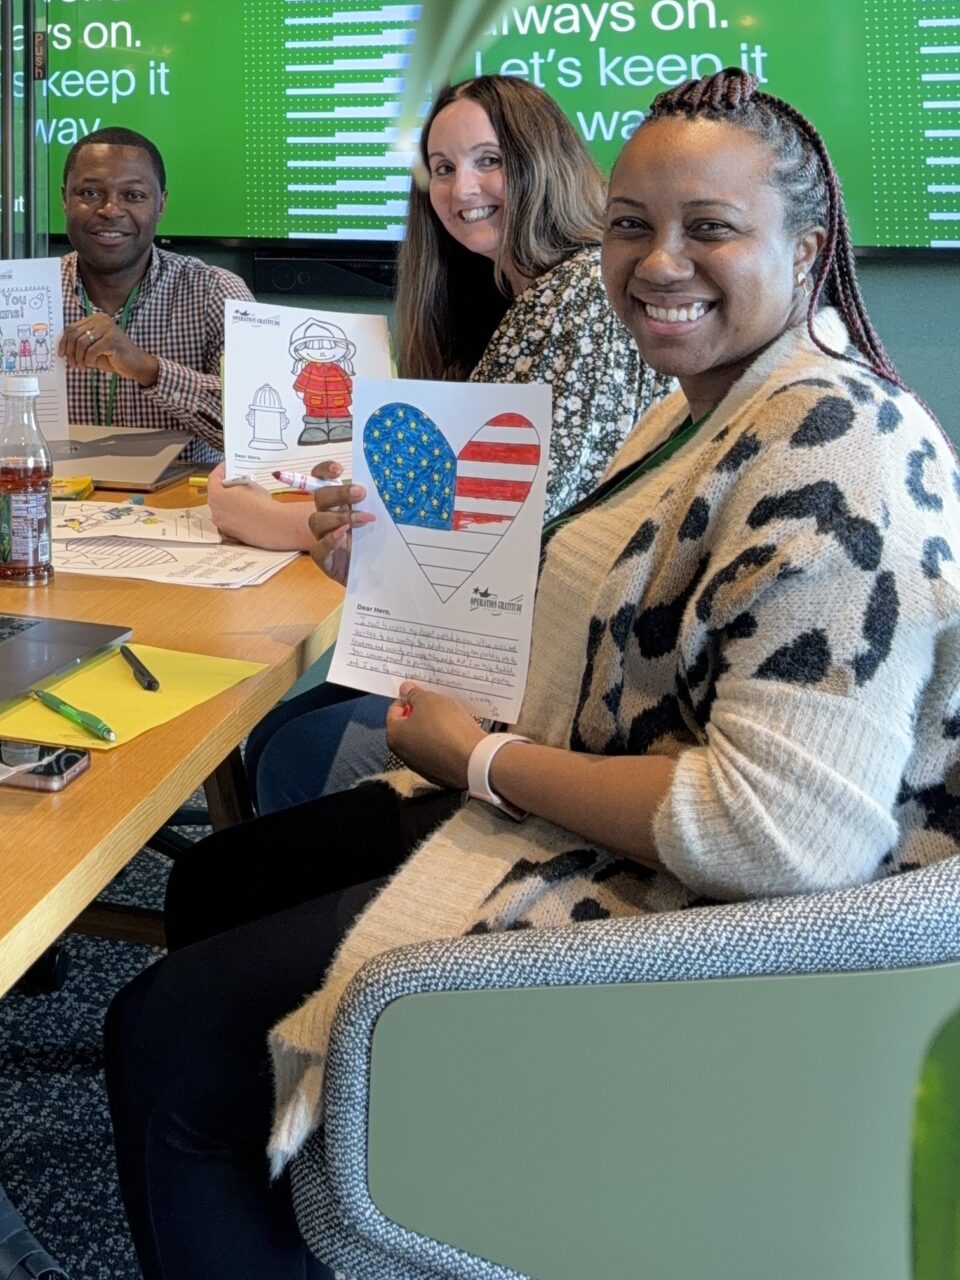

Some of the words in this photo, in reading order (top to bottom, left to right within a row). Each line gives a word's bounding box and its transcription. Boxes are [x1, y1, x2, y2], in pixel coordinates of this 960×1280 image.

[83, 19, 141, 50] on.
[149, 60, 170, 96] it
[2, 293, 27, 306] You
[357, 604, 372, 612] Dear
[469, 597, 497, 609] OPERATION
[498, 601, 522, 613] GRATITUDE
